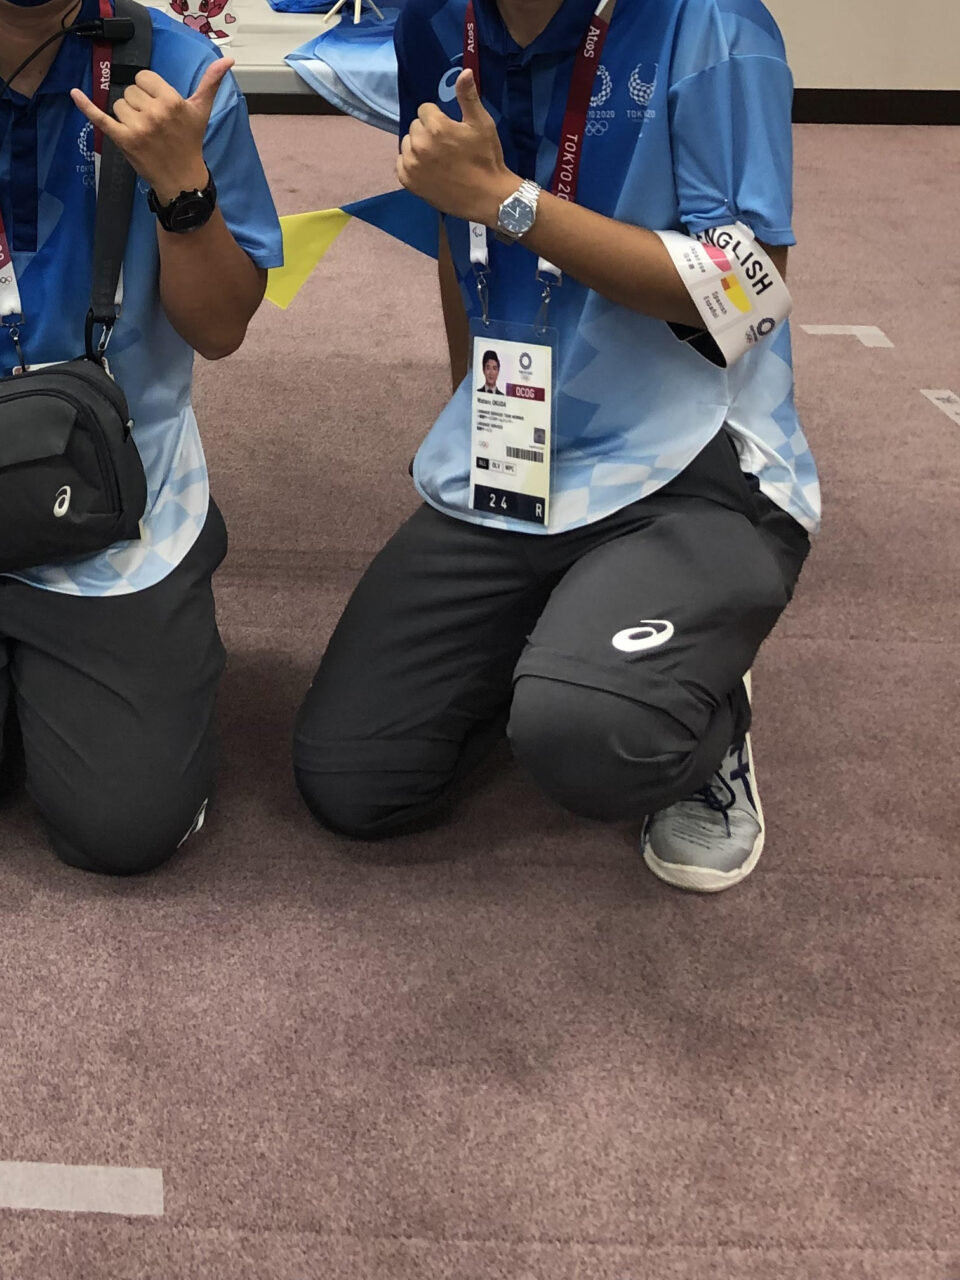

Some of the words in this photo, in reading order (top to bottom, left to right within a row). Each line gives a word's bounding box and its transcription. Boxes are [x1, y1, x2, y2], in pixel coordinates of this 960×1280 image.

[466, 22, 475, 54] Atos
[583, 25, 601, 58] Atos
[100, 61, 111, 91] Atos
[596, 110, 616, 119] 2020
[560, 134, 579, 182] TOKYO
[515, 386, 535, 398] OCOG
[535, 503, 543, 517] R
